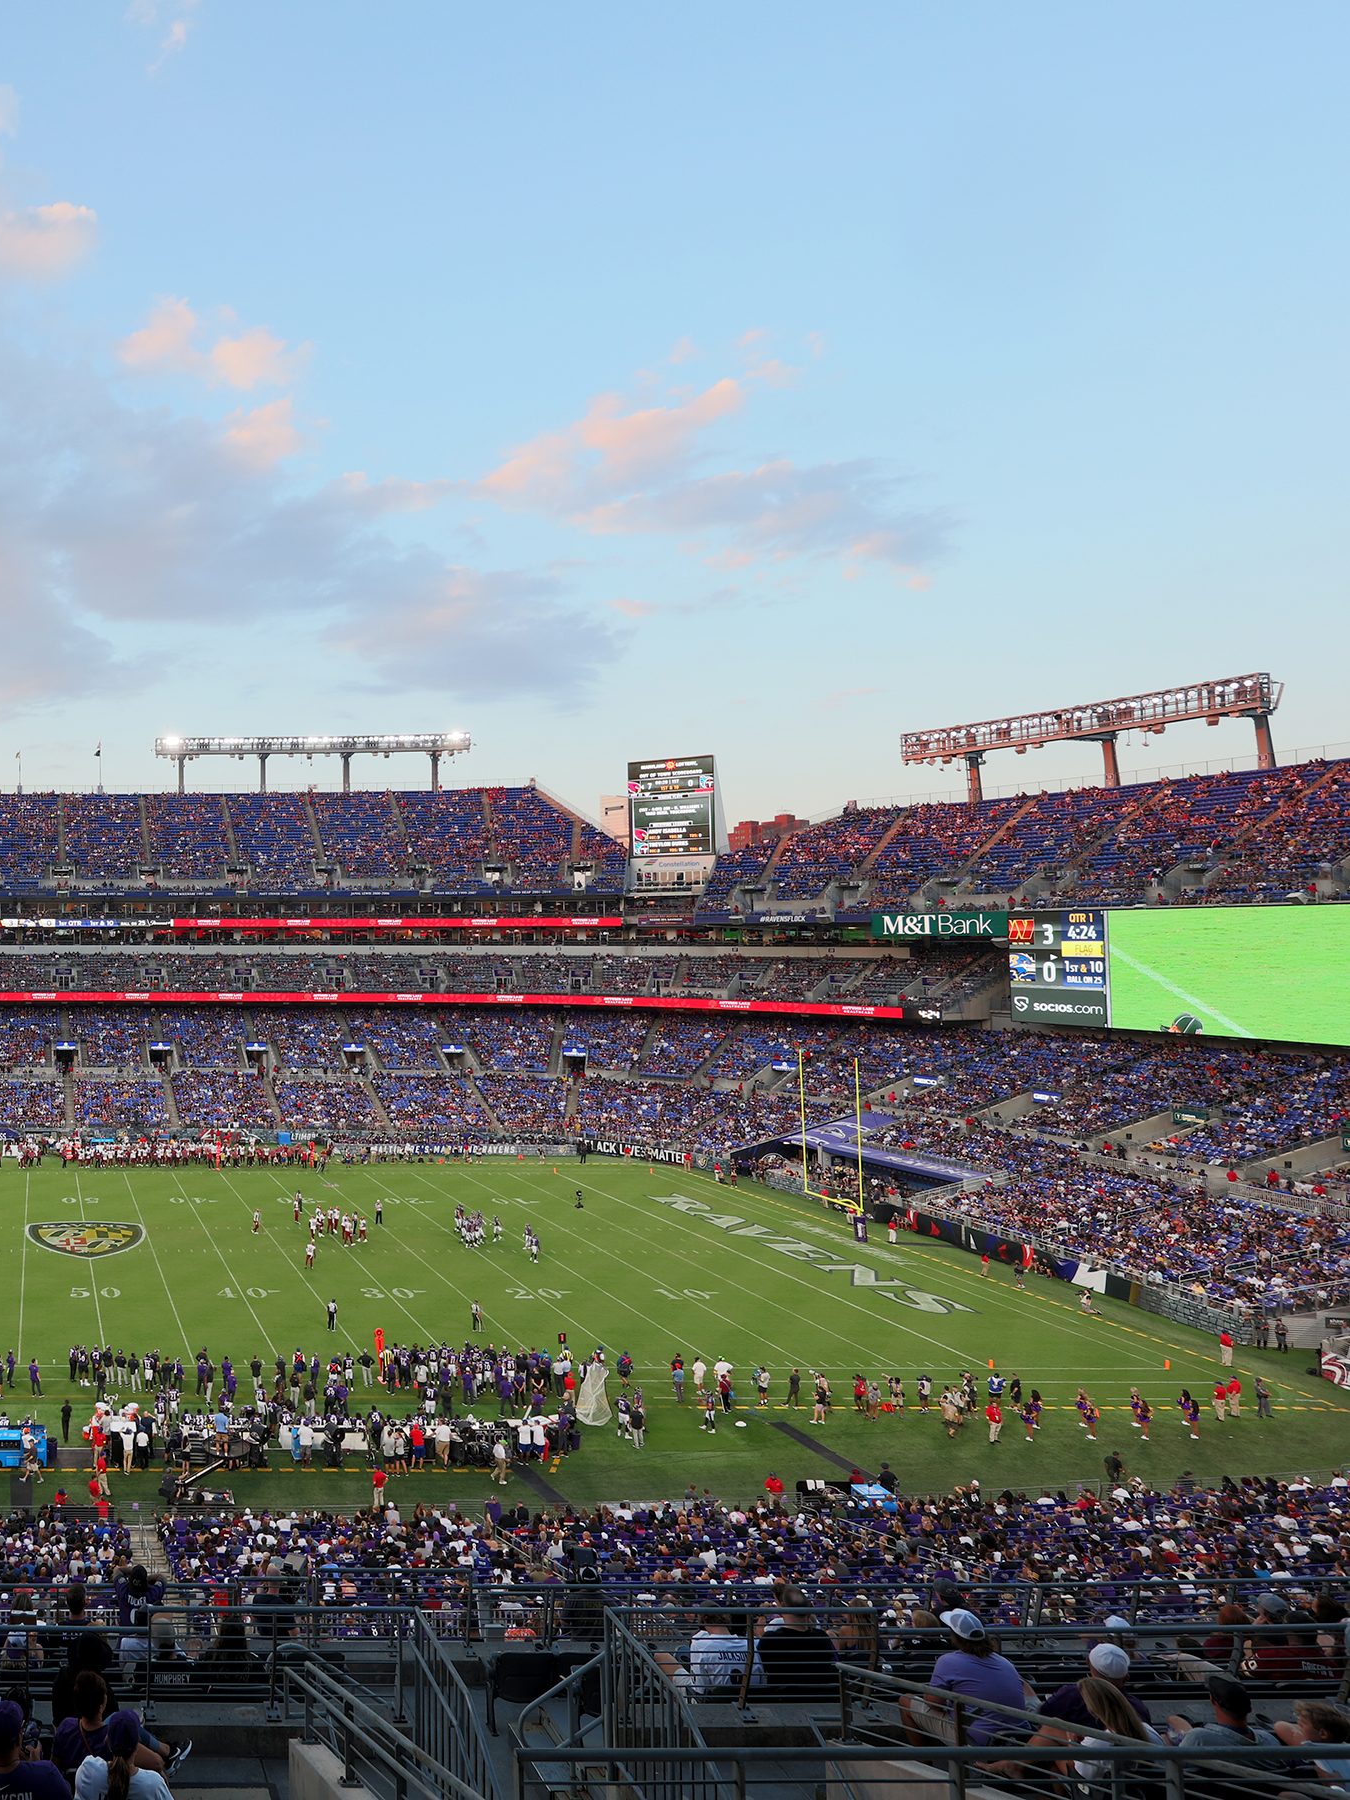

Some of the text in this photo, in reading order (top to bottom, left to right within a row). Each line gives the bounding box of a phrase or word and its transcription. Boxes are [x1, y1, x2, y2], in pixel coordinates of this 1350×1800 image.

[1069, 913, 1093, 922] QTR 1
[882, 914, 993, 934] M&T Bank
[1042, 924, 1054, 945] 3
[1068, 925, 1097, 939] 4:24
[1075, 945, 1093, 953] FLAG
[1043, 961, 1056, 982] 0
[1080, 964, 1087, 972] &
[1089, 961, 1103, 973] 10
[1033, 1002, 1103, 1014] socios.com
[643, 1192, 983, 1315] RAVENS
[70, 1287, 121, 1299] 50
[217, 1287, 267, 1299] 40
[362, 1287, 416, 1299] 30
[505, 1287, 564, 1300] 20
[654, 1288, 711, 1301] 10
[127, 1595, 146, 1606] TUCKER
[154, 1674, 190, 1684] HUMPHREY
